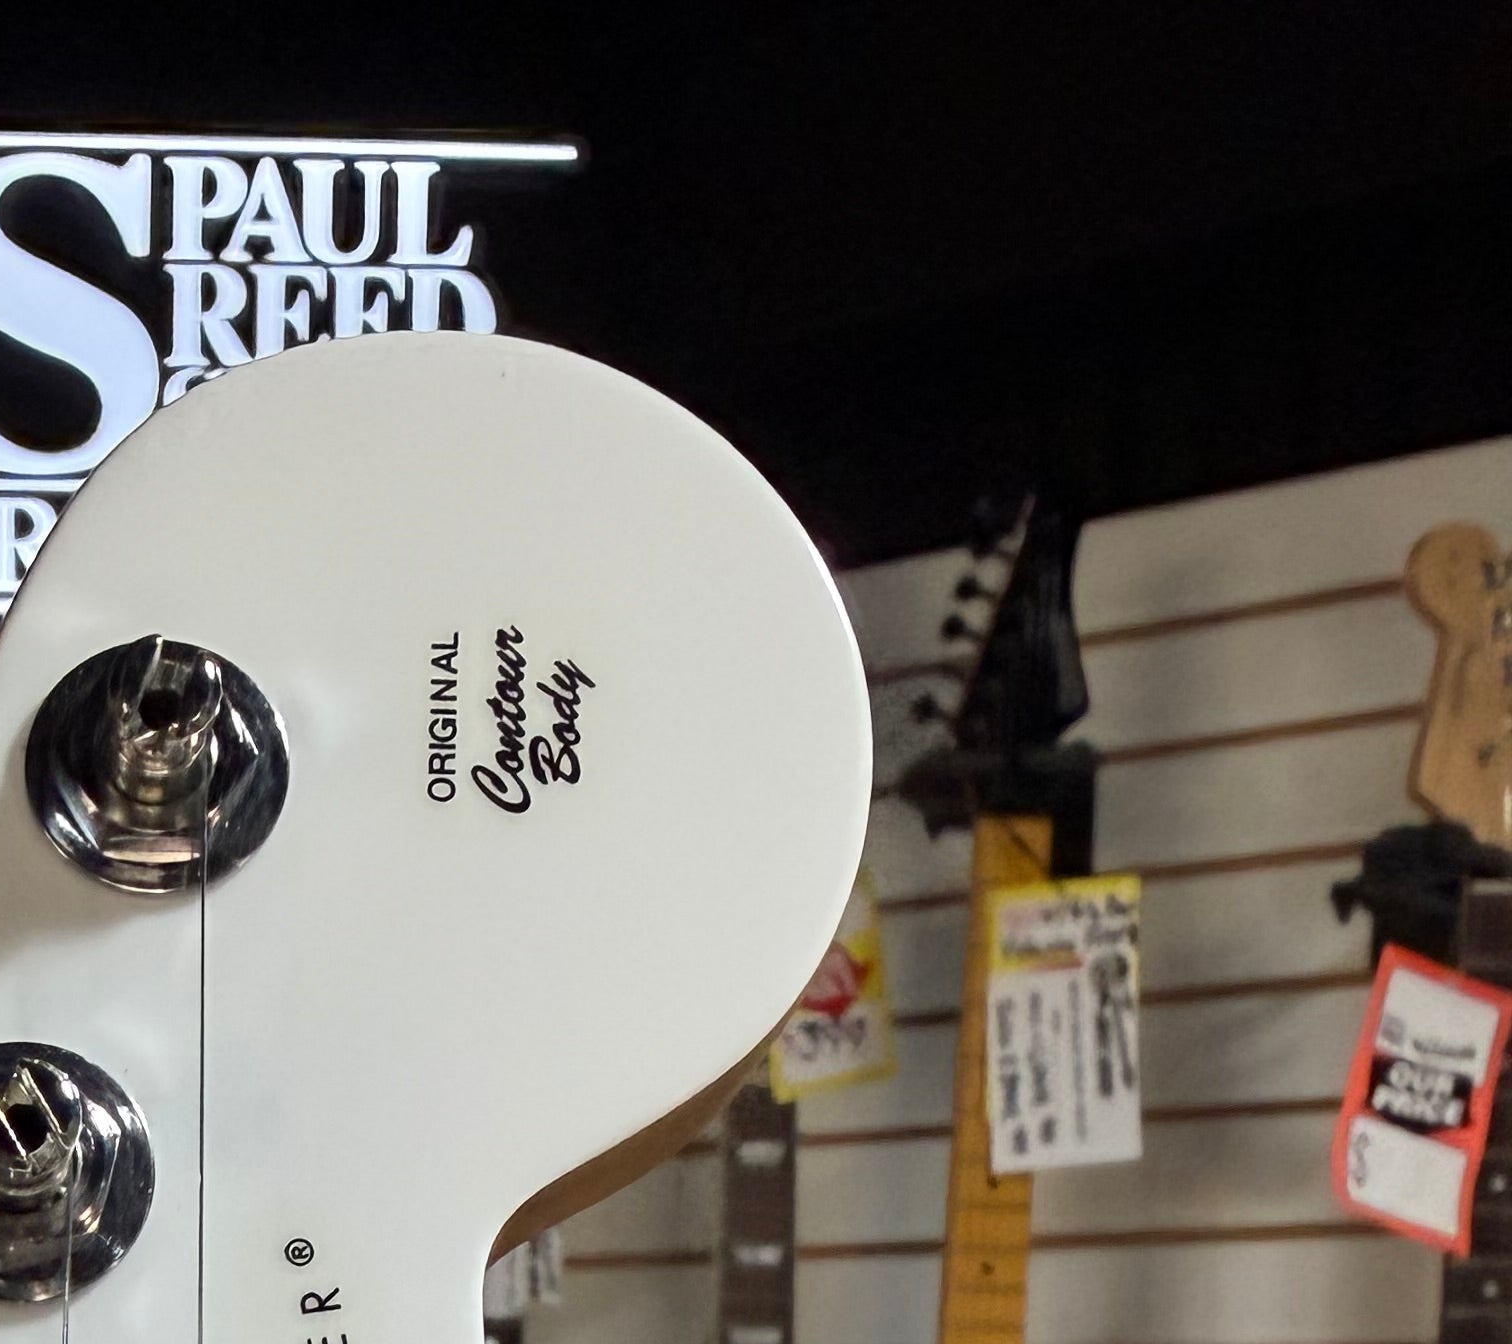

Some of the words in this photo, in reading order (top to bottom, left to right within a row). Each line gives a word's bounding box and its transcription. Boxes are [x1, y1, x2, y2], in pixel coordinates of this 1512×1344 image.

[163, 154, 474, 267] PAUL
[426, 631, 459, 803] ORIGINAL
[470, 624, 531, 814] Contour
[528, 658, 596, 785] Body
